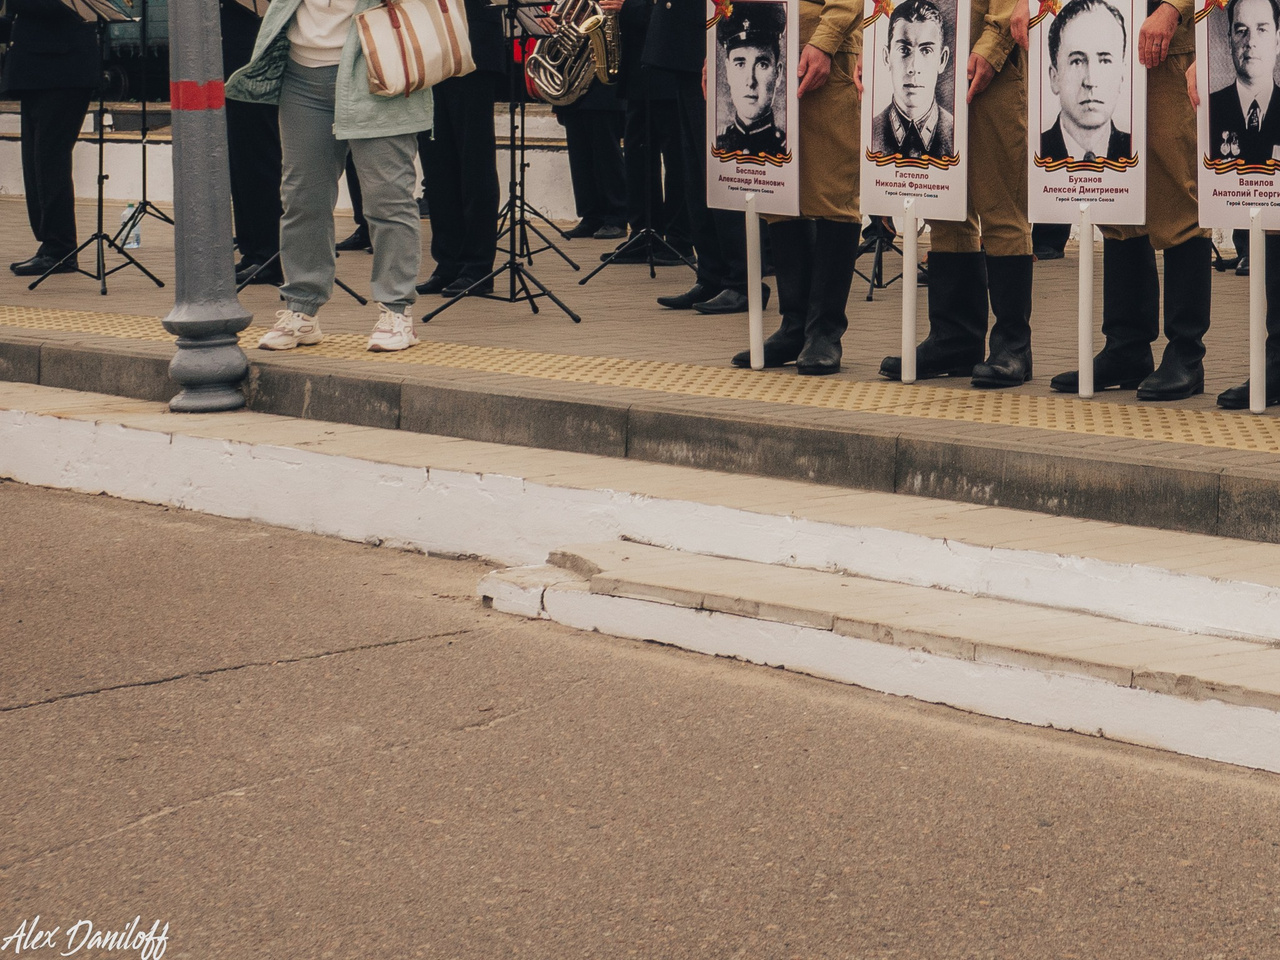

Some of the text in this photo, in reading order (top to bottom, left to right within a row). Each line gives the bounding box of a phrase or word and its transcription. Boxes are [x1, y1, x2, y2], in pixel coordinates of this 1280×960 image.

[736, 167, 766, 175] Беспалов
[895, 171, 929, 179] Гастелло
[719, 175, 784, 187] Александр Иванович
[1069, 176, 1102, 184] Буханов
[1239, 178, 1273, 186] Вавилов
[876, 180, 949, 191] Николай Францевич
[1079, 186, 1128, 195] Дмитриевич
[1213, 189, 1251, 197] Анатолий
